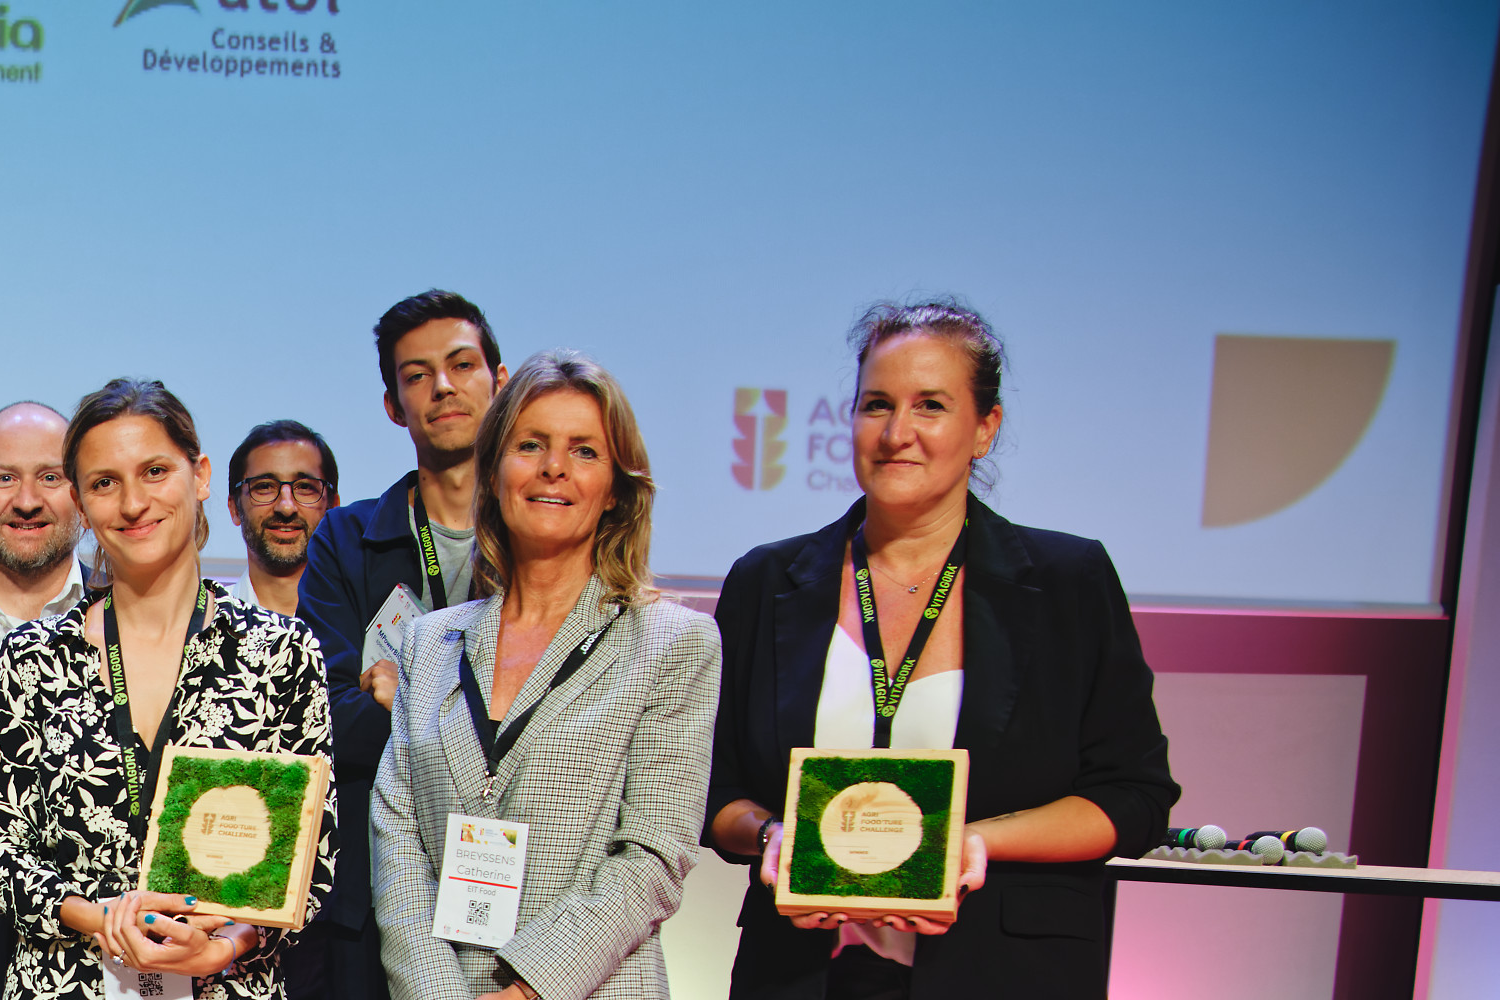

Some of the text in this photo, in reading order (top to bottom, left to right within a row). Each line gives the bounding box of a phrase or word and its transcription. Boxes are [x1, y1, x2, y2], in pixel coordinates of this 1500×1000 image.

[211, 28, 337, 54] Conseils &
[142, 47, 341, 78] Développements
[420, 525, 437, 566] VITAGORA
[857, 579, 875, 624] VITAGORA
[930, 563, 958, 608] VITAGORA
[108, 643, 125, 693] VITAGORA
[888, 658, 916, 705] VITAGORA
[124, 747, 139, 802] VITAGORA
[218, 830, 258, 838] CHALLENGE
[456, 849, 516, 866] BREYSSENS
[457, 865, 511, 881] Catherine
[467, 885, 497, 897] EIT Food
